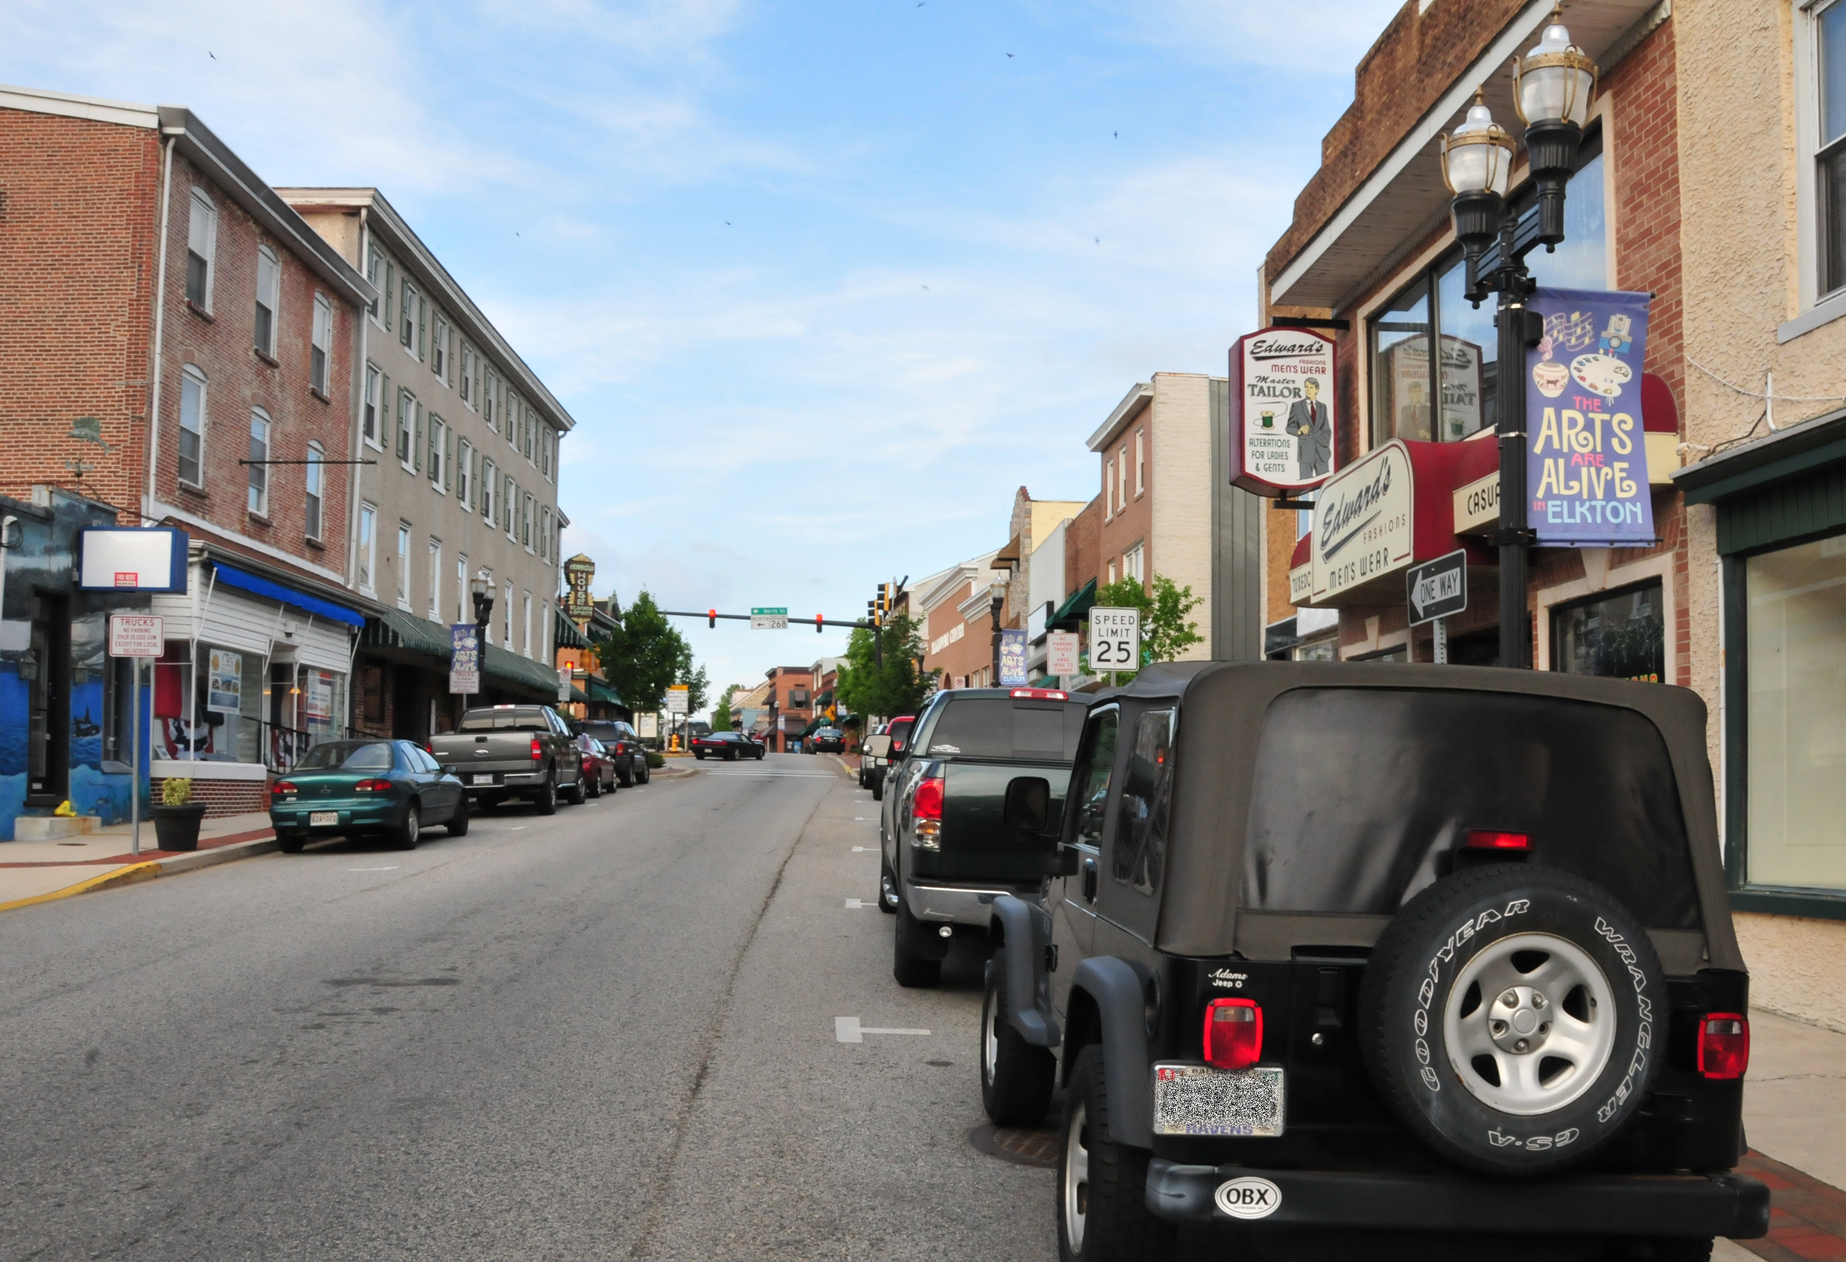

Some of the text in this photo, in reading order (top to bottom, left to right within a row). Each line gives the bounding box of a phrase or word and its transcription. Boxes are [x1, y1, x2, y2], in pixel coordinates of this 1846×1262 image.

[1250, 339, 1323, 356] Edward's
[1271, 364, 1327, 375] MEN'S WEAR
[1255, 376, 1296, 384] Master
[1247, 384, 1302, 399] TAILOR
[1573, 396, 1602, 412] THE
[1533, 407, 1634, 455] ARTS
[1249, 438, 1291, 448] ALTERATIONS
[1251, 450, 1289, 461] FOR LADIES
[1571, 452, 1606, 468] ARE
[1255, 463, 1286, 473] & GENTS
[1536, 458, 1637, 500] ALIVE
[1320, 456, 1392, 551] Edward's
[1533, 500, 1643, 524] IN ELKTON
[1363, 513, 1406, 545] FASHIONS
[1329, 547, 1389, 590] MEN'S WEAR
[1420, 571, 1459, 604] ONE WAY
[120, 618, 155, 627] TRUCKS
[771, 620, 786, 628] 268
[1095, 615, 1135, 625] SPEED
[1099, 628, 1130, 638] LIMIT
[454, 650, 477, 662] ARTS
[1097, 640, 1131, 663] 25
[1001, 656, 1024, 667] ARTS
[1208, 968, 1248, 980] Adams
[1212, 979, 1233, 988] Jeep
[1414, 899, 1530, 1092] GOODYEAR
[1594, 917, 1653, 1123] WRANGLER
[1226, 1188, 1269, 1205] OBX
